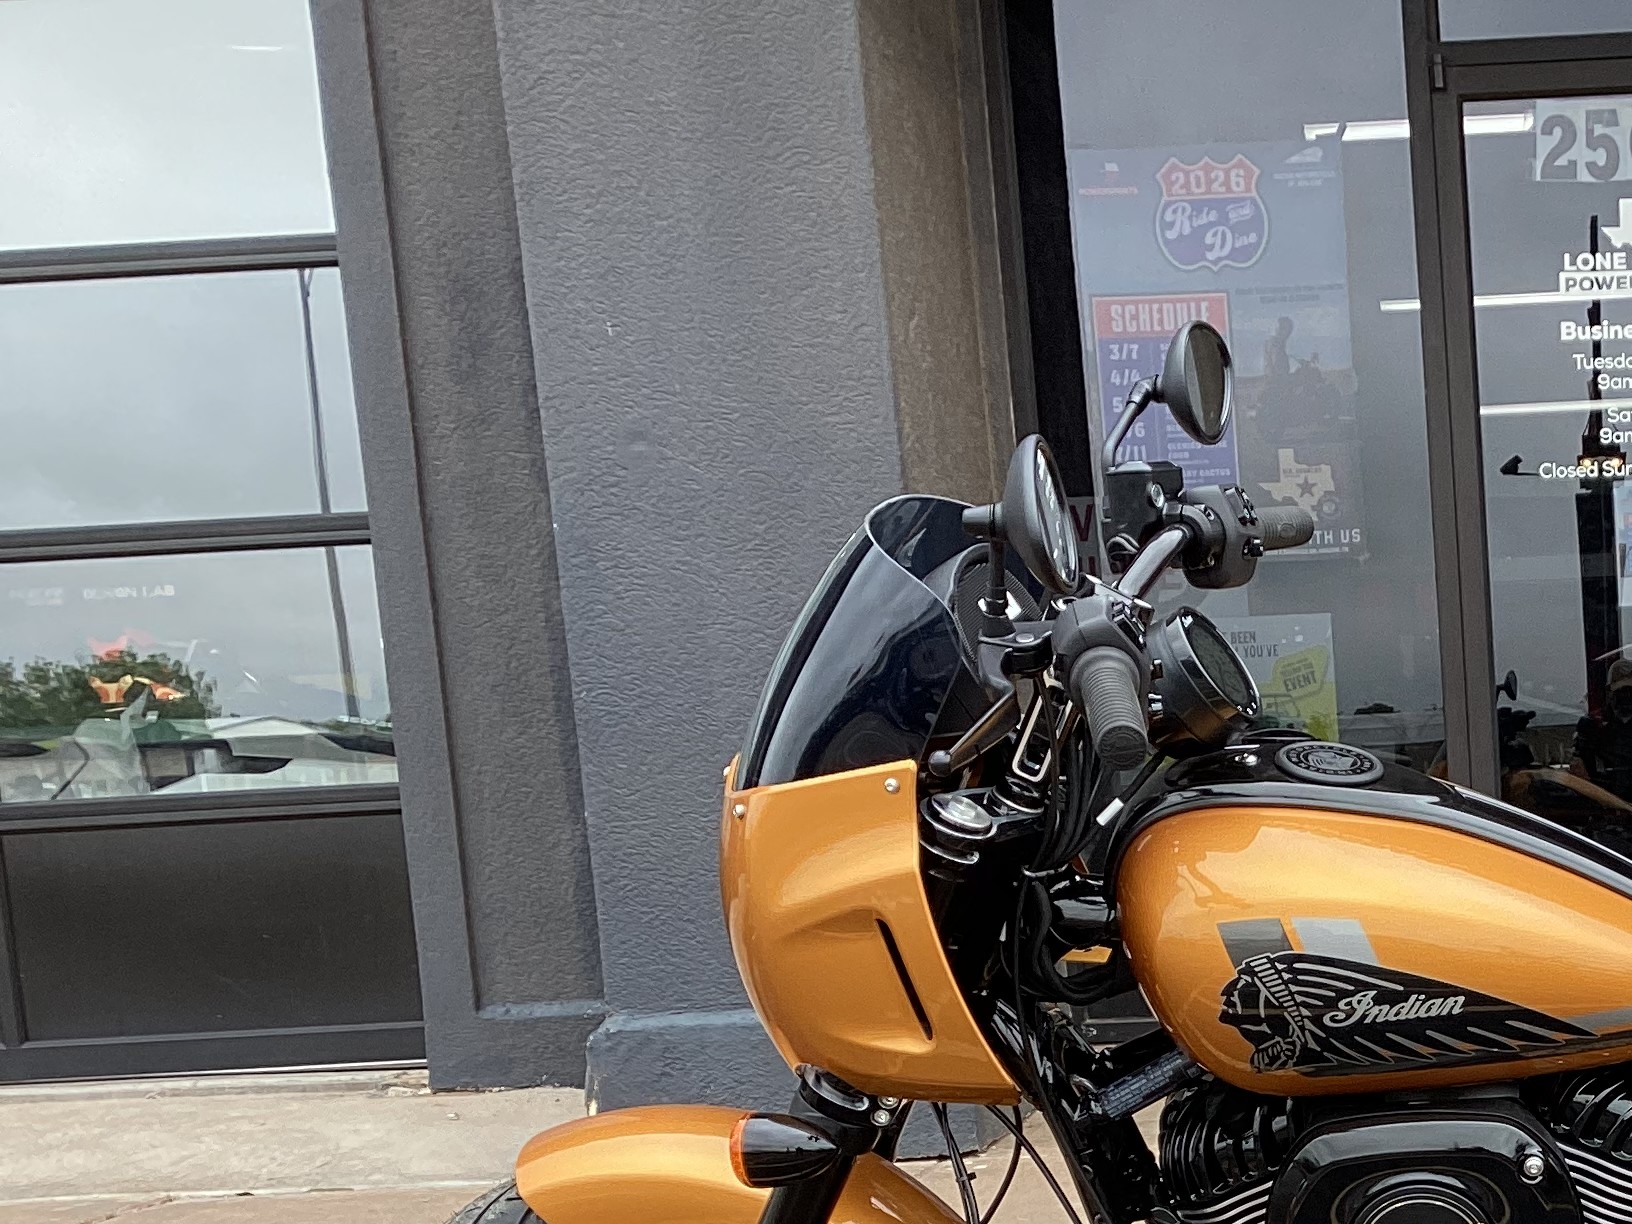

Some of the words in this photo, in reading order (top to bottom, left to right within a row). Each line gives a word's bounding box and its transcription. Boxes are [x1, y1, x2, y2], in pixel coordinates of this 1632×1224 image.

[1171, 168, 1246, 196] 2026
[1164, 201, 1218, 239] Ride
[1205, 225, 1258, 260] Dine
[1563, 251, 1627, 270] LONE
[1539, 461, 1599, 480] Closed
[1341, 529, 1361, 543] US
[1231, 631, 1256, 644] BEEN
[1244, 644, 1279, 658] YOU'VE
[1284, 670, 1316, 692] EVENT
[1322, 990, 1466, 1028] Indian
